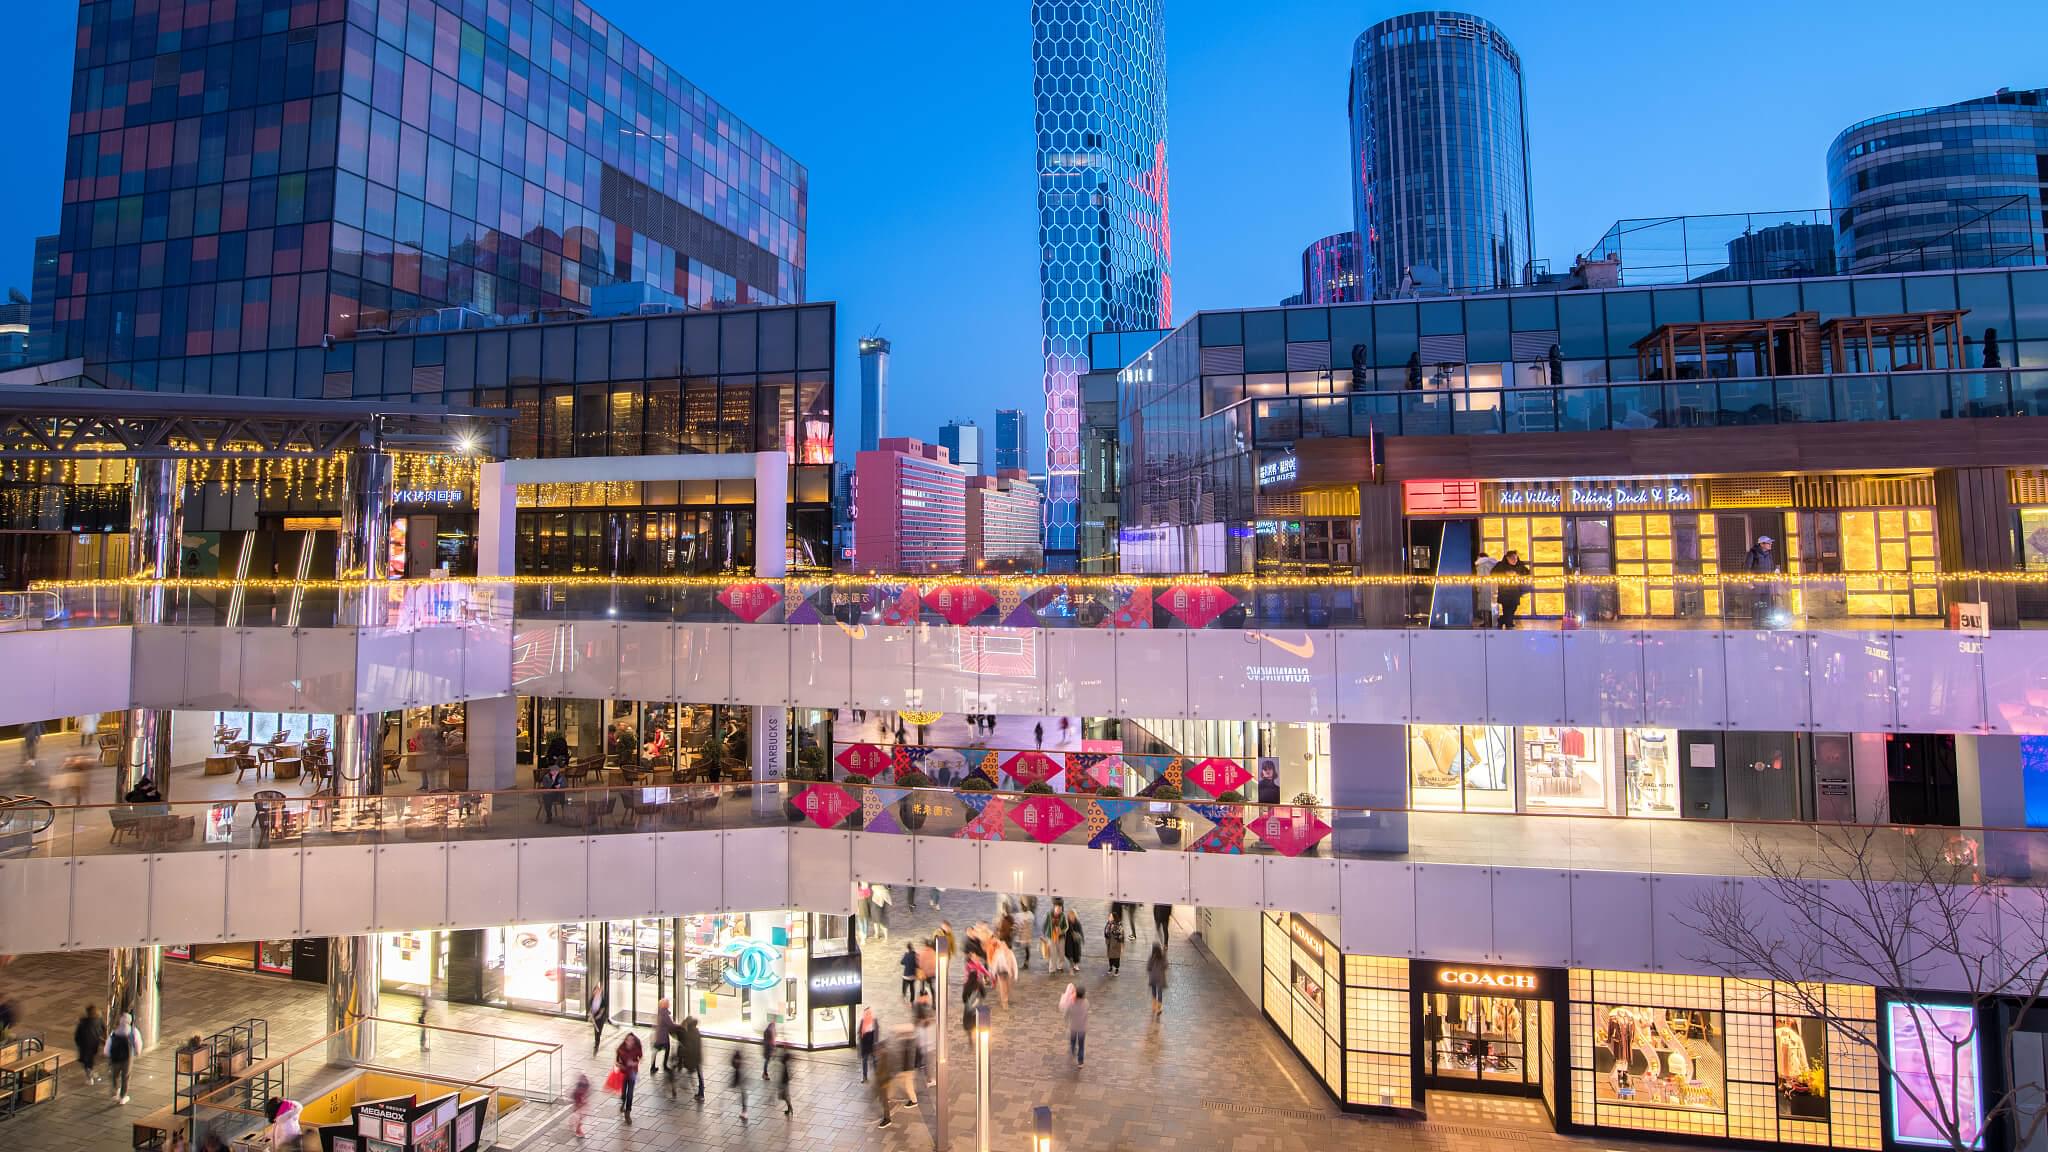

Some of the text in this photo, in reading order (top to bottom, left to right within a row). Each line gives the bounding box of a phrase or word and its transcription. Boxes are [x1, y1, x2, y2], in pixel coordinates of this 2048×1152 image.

[1437, 17, 1489, 44] 三里屯
[1525, 488, 1561, 506] Village
[1572, 488, 1613, 508] Peking
[1616, 488, 1648, 504] Duck
[1652, 486, 1663, 502] &
[1667, 487, 1692, 503] Bar
[768, 718, 779, 777] STARBUCKS
[811, 974, 862, 988] CHANEL
[1440, 970, 1537, 988] COACH
[360, 1106, 405, 1122] MEGABOX
